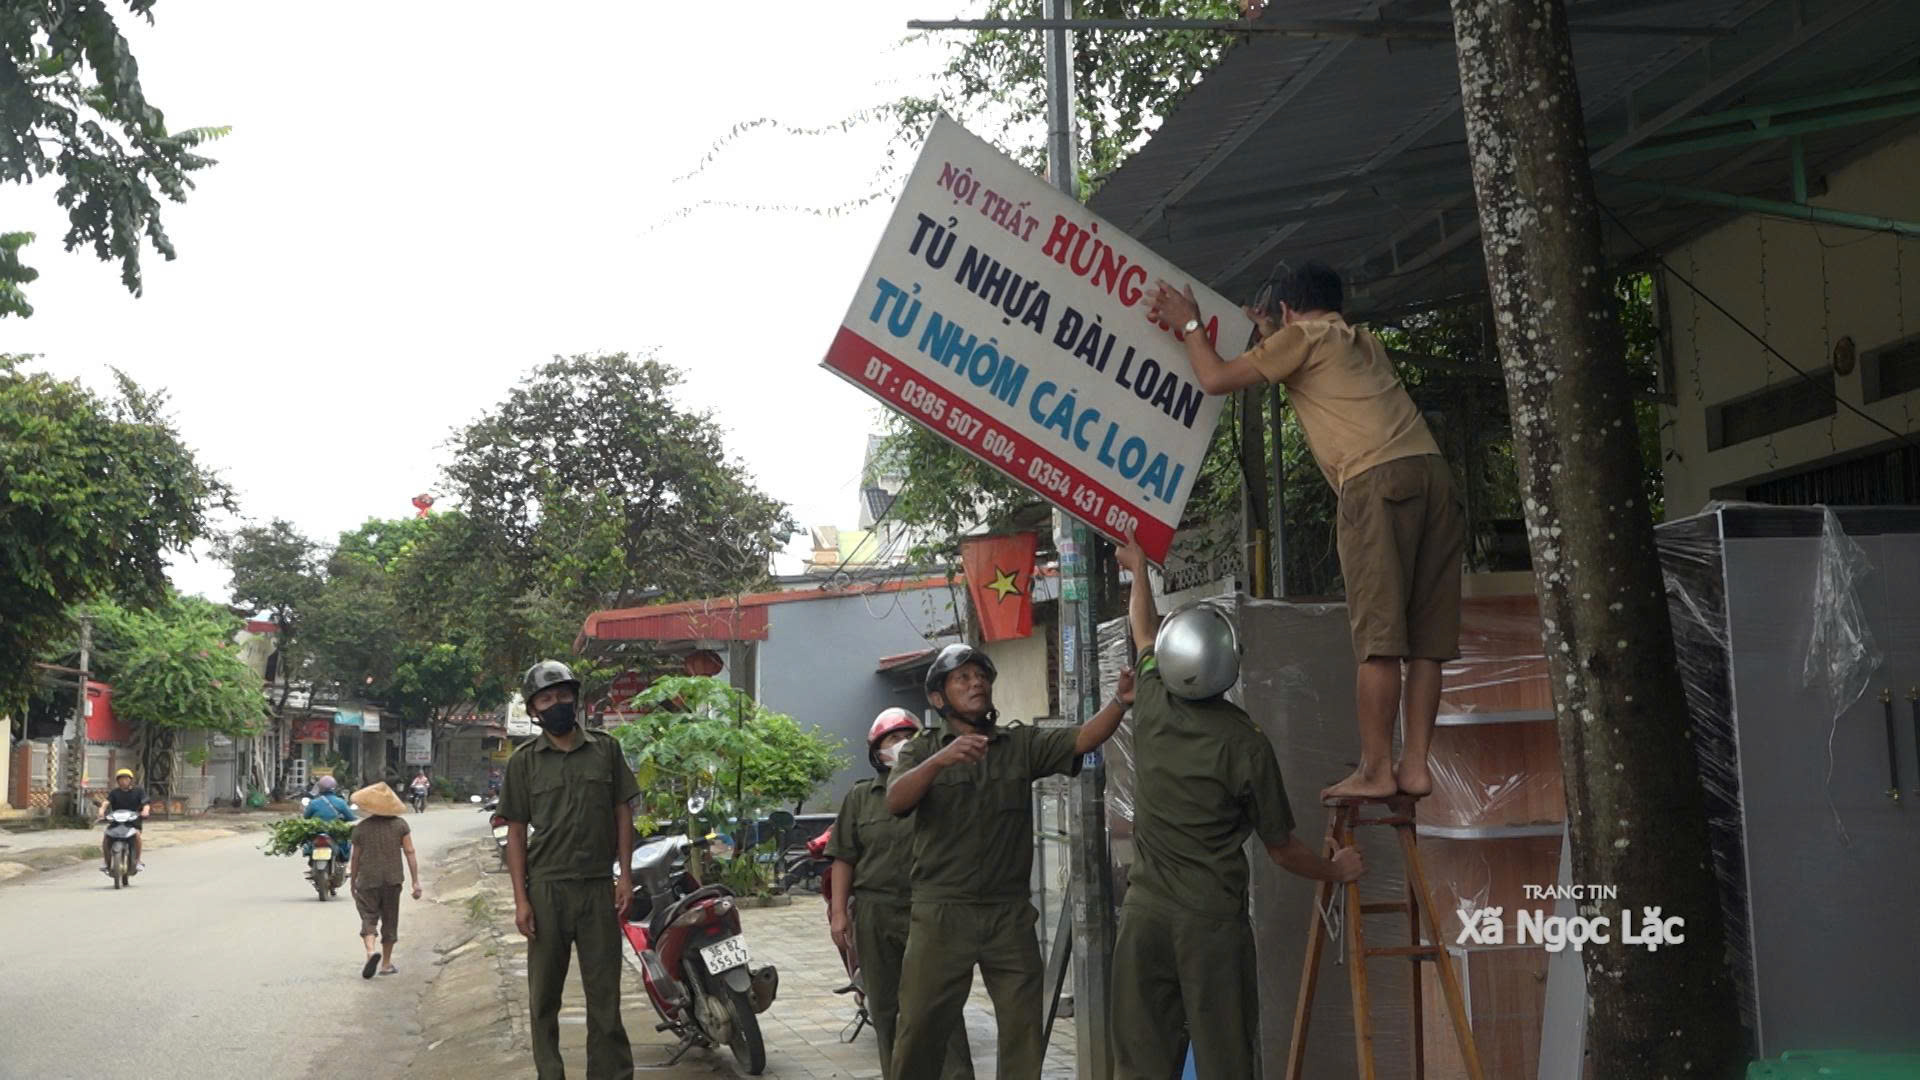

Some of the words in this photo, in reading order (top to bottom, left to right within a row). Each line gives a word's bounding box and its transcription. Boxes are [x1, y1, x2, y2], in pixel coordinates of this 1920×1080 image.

[908, 213, 959, 269] TỦ
[955, 246, 1051, 334] NHỰA
[1053, 306, 1116, 373] ĐÀI
[1115, 346, 1205, 429] LOAN
[937, 161, 981, 206] NỘI
[980, 189, 1040, 242] THẤT
[1042, 214, 1148, 307] HÙNG
[864, 356, 893, 386] ĐT
[900, 379, 948, 421] 0385
[946, 407, 984, 441] 507
[982, 428, 1016, 463] 604
[1027, 456, 1071, 499] 0354
[1072, 483, 1104, 518] 431
[869, 278, 923, 338] TỦ
[918, 311, 1030, 407] NHÔM
[1028, 387, 1102, 452] CÁC
[1096, 426, 1186, 504] LOẠI
